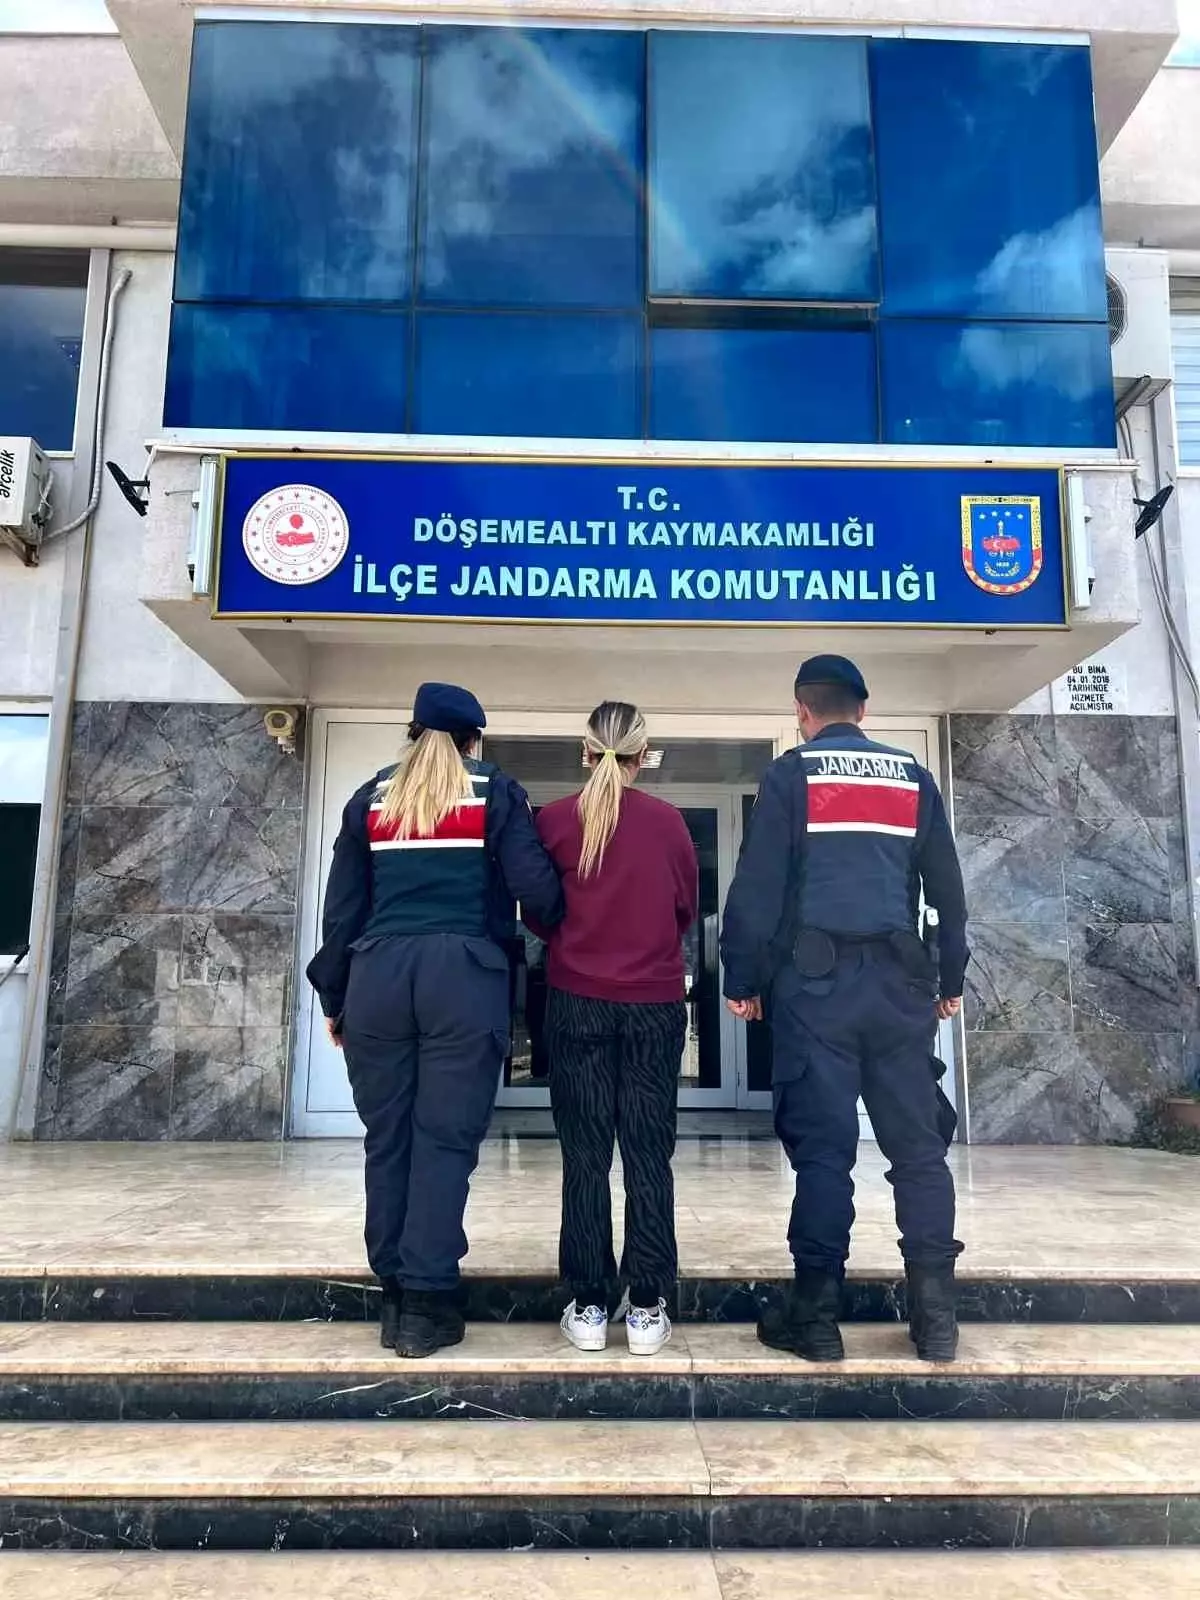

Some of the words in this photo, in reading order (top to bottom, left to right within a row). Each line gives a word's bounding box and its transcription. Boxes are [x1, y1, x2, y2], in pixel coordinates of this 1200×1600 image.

[0, 449, 15, 498] arçelik
[618, 487, 680, 511] T.C.
[414, 513, 616, 548] DÖŞEMEALTI
[628, 517, 874, 547] KAYMAKAMLIĞI
[354, 555, 437, 601] İLÇE
[450, 566, 657, 599] JANDARMA
[671, 564, 936, 602] KOMUTANLIĞI
[817, 756, 909, 780] JANDARMA
